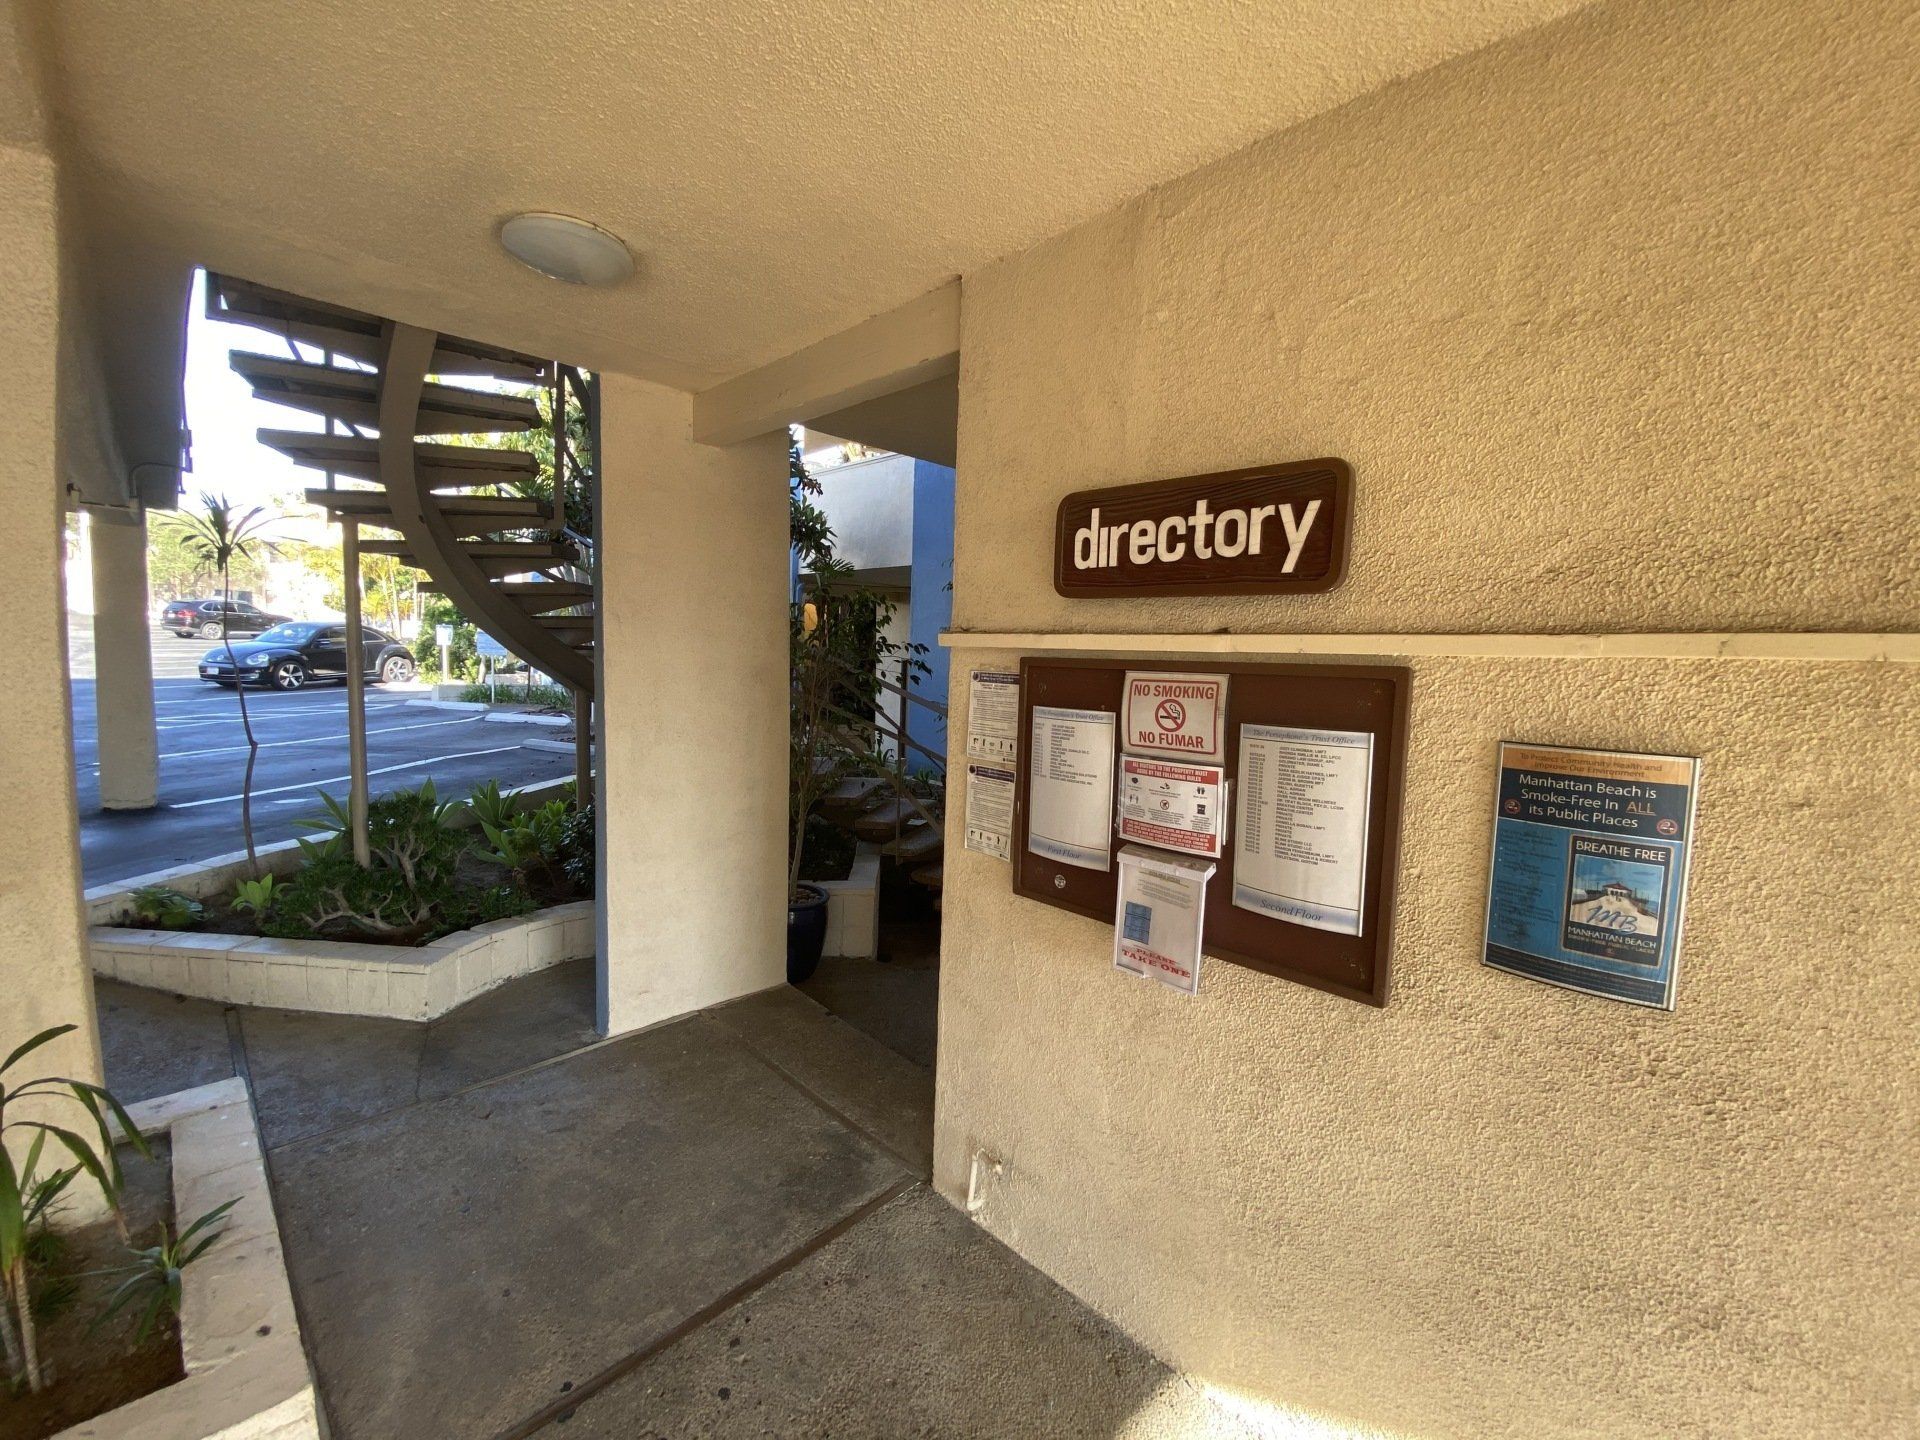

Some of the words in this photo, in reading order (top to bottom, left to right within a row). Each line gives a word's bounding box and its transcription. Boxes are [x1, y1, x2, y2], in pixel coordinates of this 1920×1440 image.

[1074, 500, 1321, 573] directory
[1134, 684, 1151, 696] NO
[1153, 685, 1215, 699] SMOKING
[1138, 731, 1155, 743] NO
[1158, 733, 1204, 748] FUMAR
[1311, 734, 1330, 743] Trust
[1332, 736, 1355, 744] Office
[1561, 755, 1612, 768] Community
[1613, 761, 1642, 770] Health
[1644, 764, 1662, 772] and
[1570, 764, 1585, 773] Our
[1587, 766, 1646, 778] Environment
[1519, 774, 1592, 793] Manhattan
[1596, 783, 1642, 798] Beach
[1645, 787, 1657, 799] is
[1521, 788, 1601, 808] Smoke-Free
[1605, 798, 1619, 810] In
[1626, 801, 1656, 814] ALL
[1529, 806, 1544, 816] its
[1547, 807, 1590, 822] Public
[1592, 813, 1639, 828] Places
[1047, 844, 1061, 855] First
[1062, 849, 1081, 859] Floor
[1576, 841, 1631, 857] BREATHE
[1634, 849, 1666, 862] FREE
[1260, 899, 1294, 917] Second
[1294, 908, 1323, 921] Floor
[1568, 926, 1623, 943] MANHATTAN
[1625, 938, 1657, 949] BEACH
[1122, 949, 1157, 967] TAKE
[1160, 963, 1191, 979] ONE
[1136, 948, 1176, 964] PLEASE
